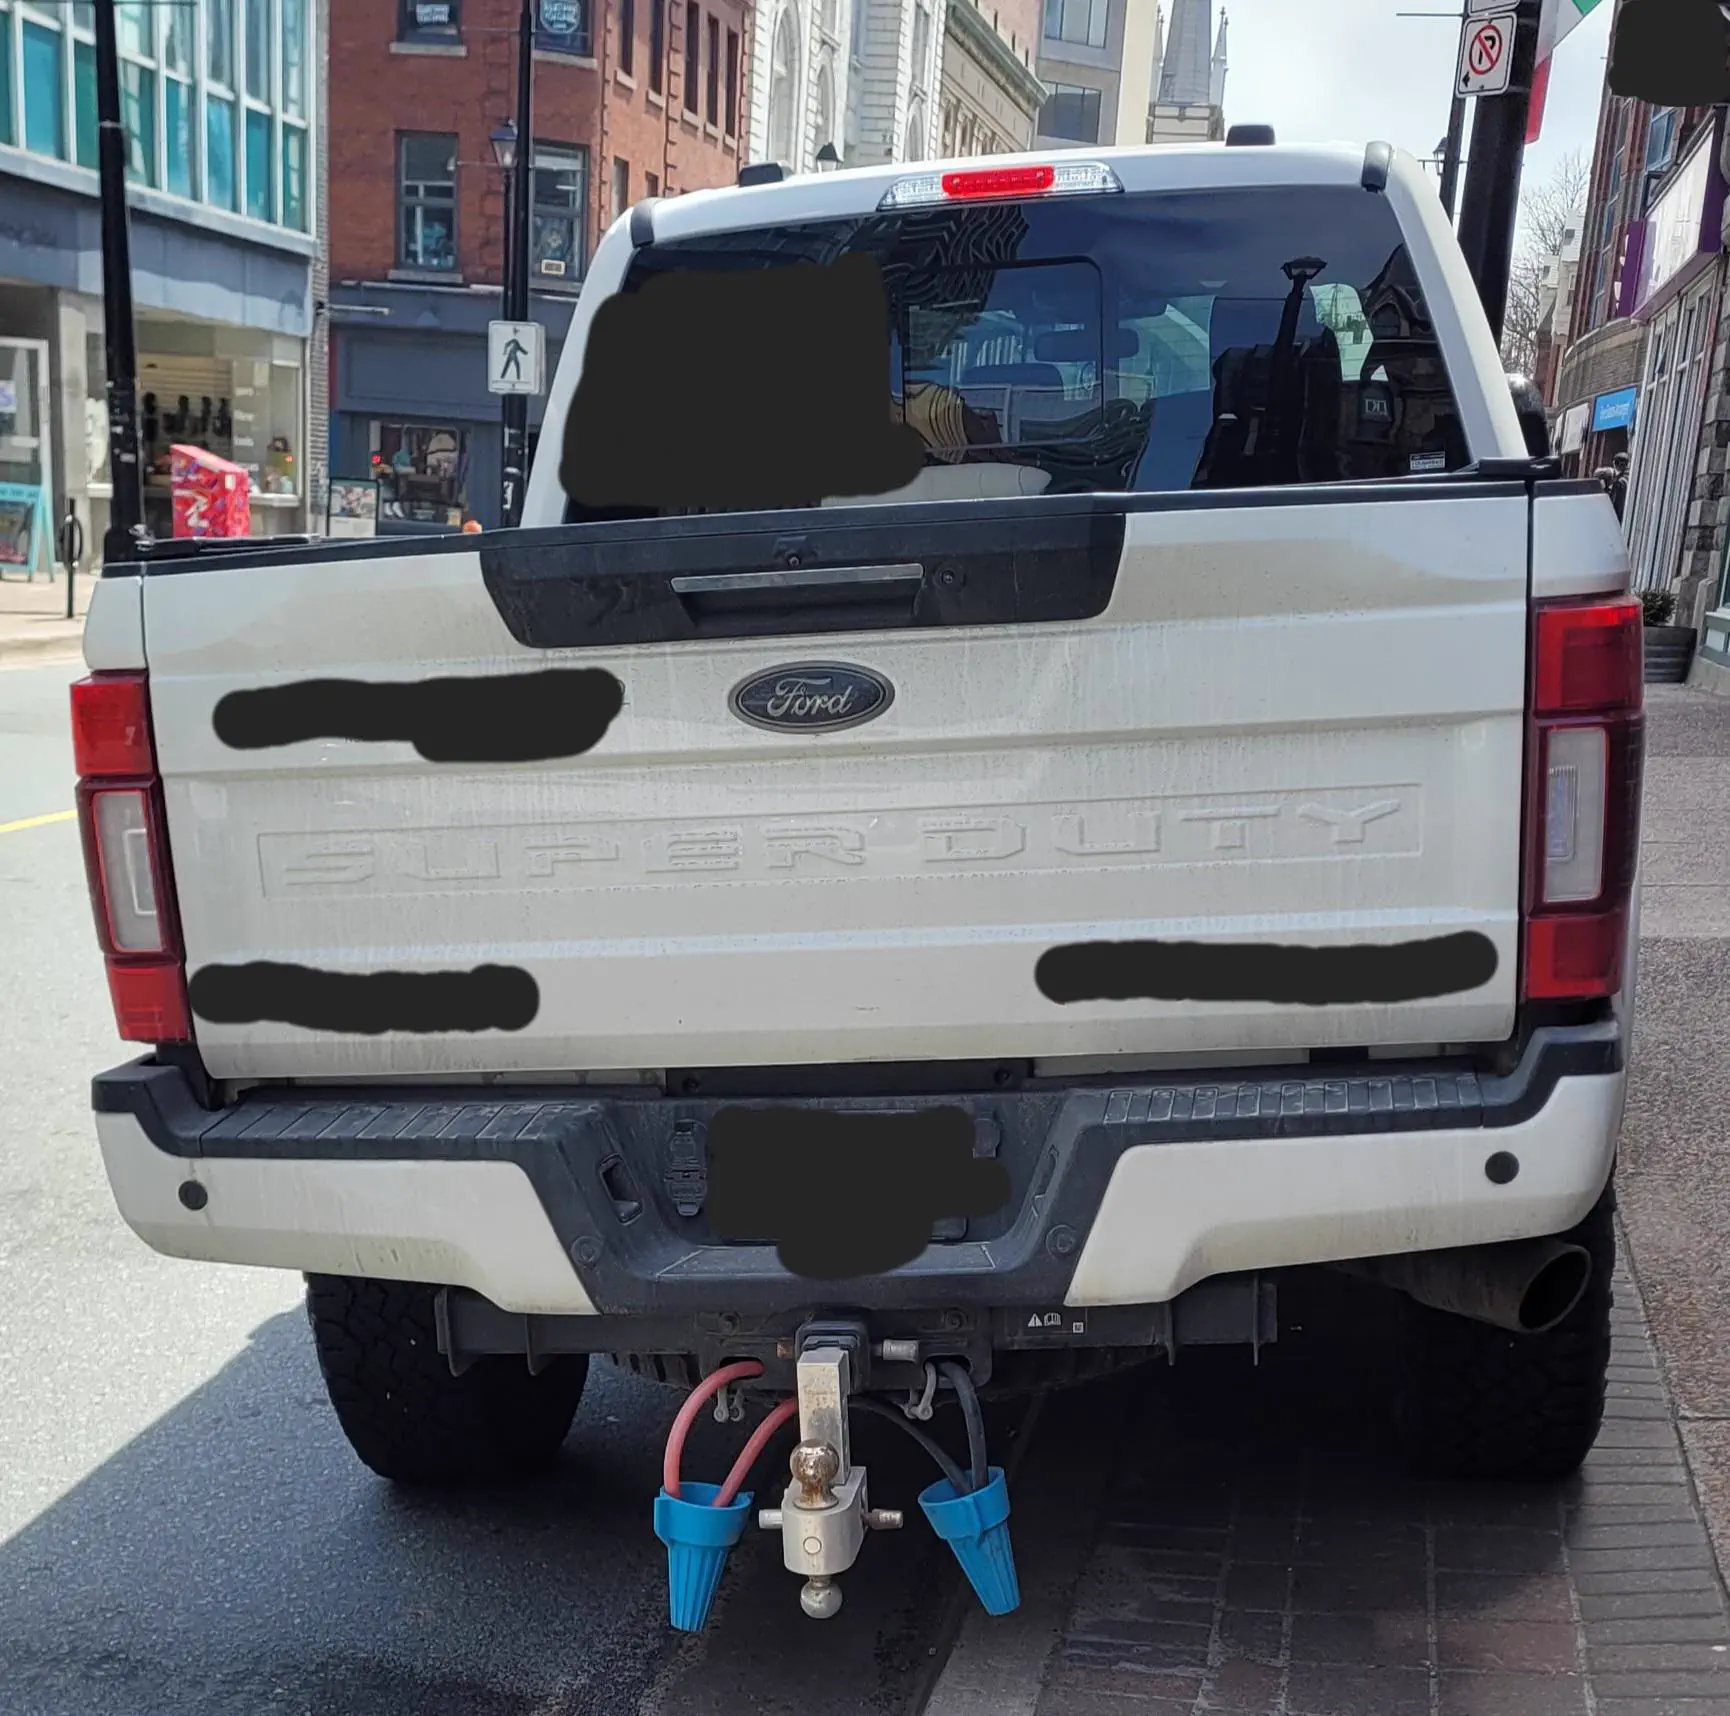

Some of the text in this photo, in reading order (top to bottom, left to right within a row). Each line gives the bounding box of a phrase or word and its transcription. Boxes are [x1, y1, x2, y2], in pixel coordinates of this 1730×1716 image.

[767, 677, 853, 716] Ford
[279, 799, 1402, 886] SUPER DUTY
